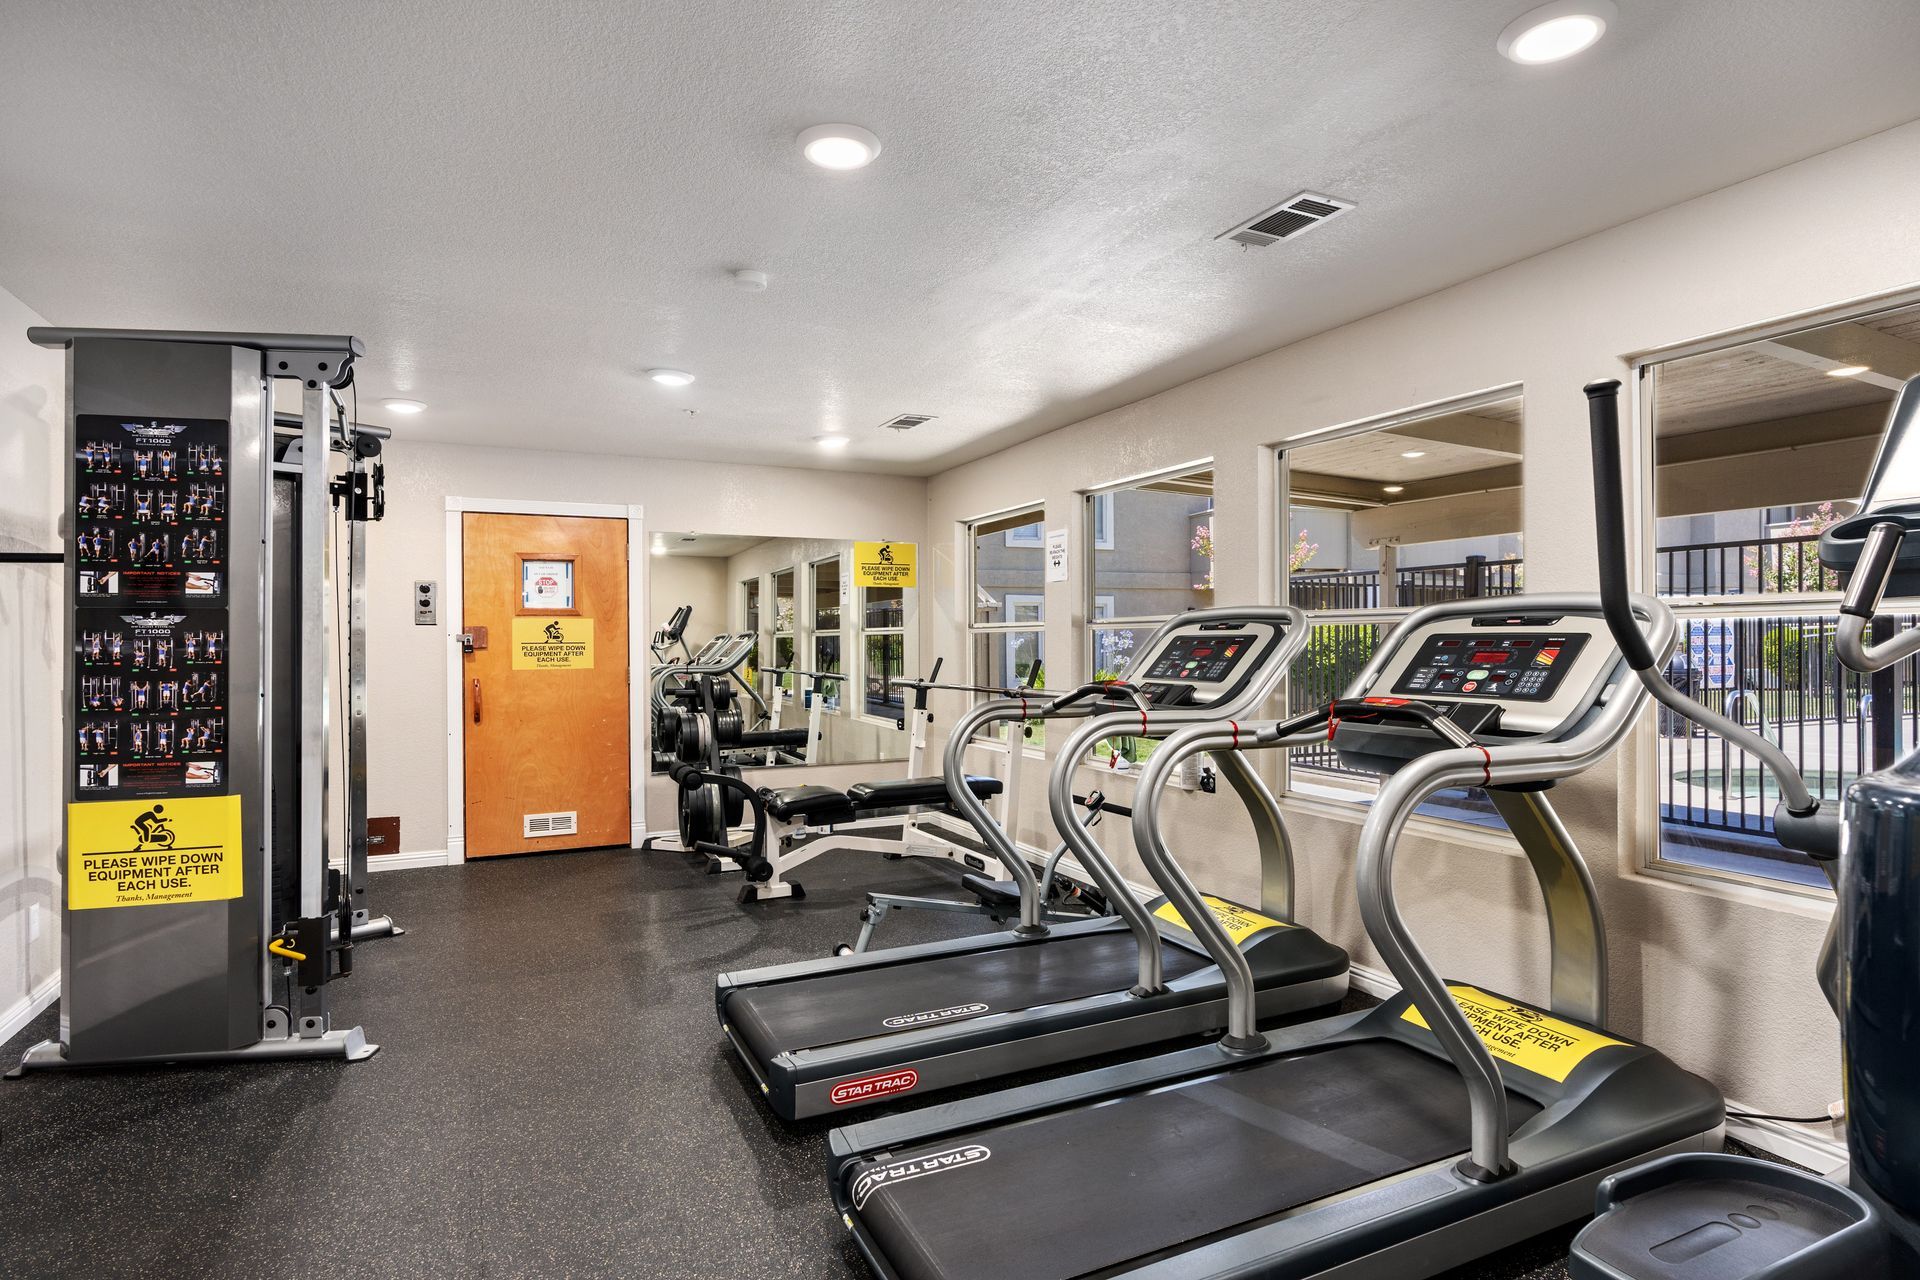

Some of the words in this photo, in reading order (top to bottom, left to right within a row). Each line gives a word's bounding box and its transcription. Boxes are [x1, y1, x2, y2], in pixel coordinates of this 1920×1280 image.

[84, 858, 137, 870] PLEASE
[142, 855, 176, 866] WIPE
[180, 852, 224, 864] DOWN
[88, 867, 171, 882] EQUIPMENT
[176, 864, 220, 876] AFTER
[118, 880, 156, 892] EACH
[160, 878, 192, 889] USE.
[116, 894, 144, 903] Thanks,
[146, 892, 192, 901] Management
[1227, 916, 1252, 928] DOWN
[892, 1014, 938, 1024] TRAC
[940, 1005, 982, 1016] STAR
[1493, 1014, 1527, 1030] WIPE
[1527, 1026, 1575, 1047] DOWN
[1492, 1032, 1521, 1050] USE.
[1513, 1031, 1562, 1053] AFTER
[838, 1084, 873, 1098] STAR
[875, 1076, 910, 1090] TRAC
[923, 1150, 981, 1170] STAR
[858, 1164, 920, 1198] TRAC
